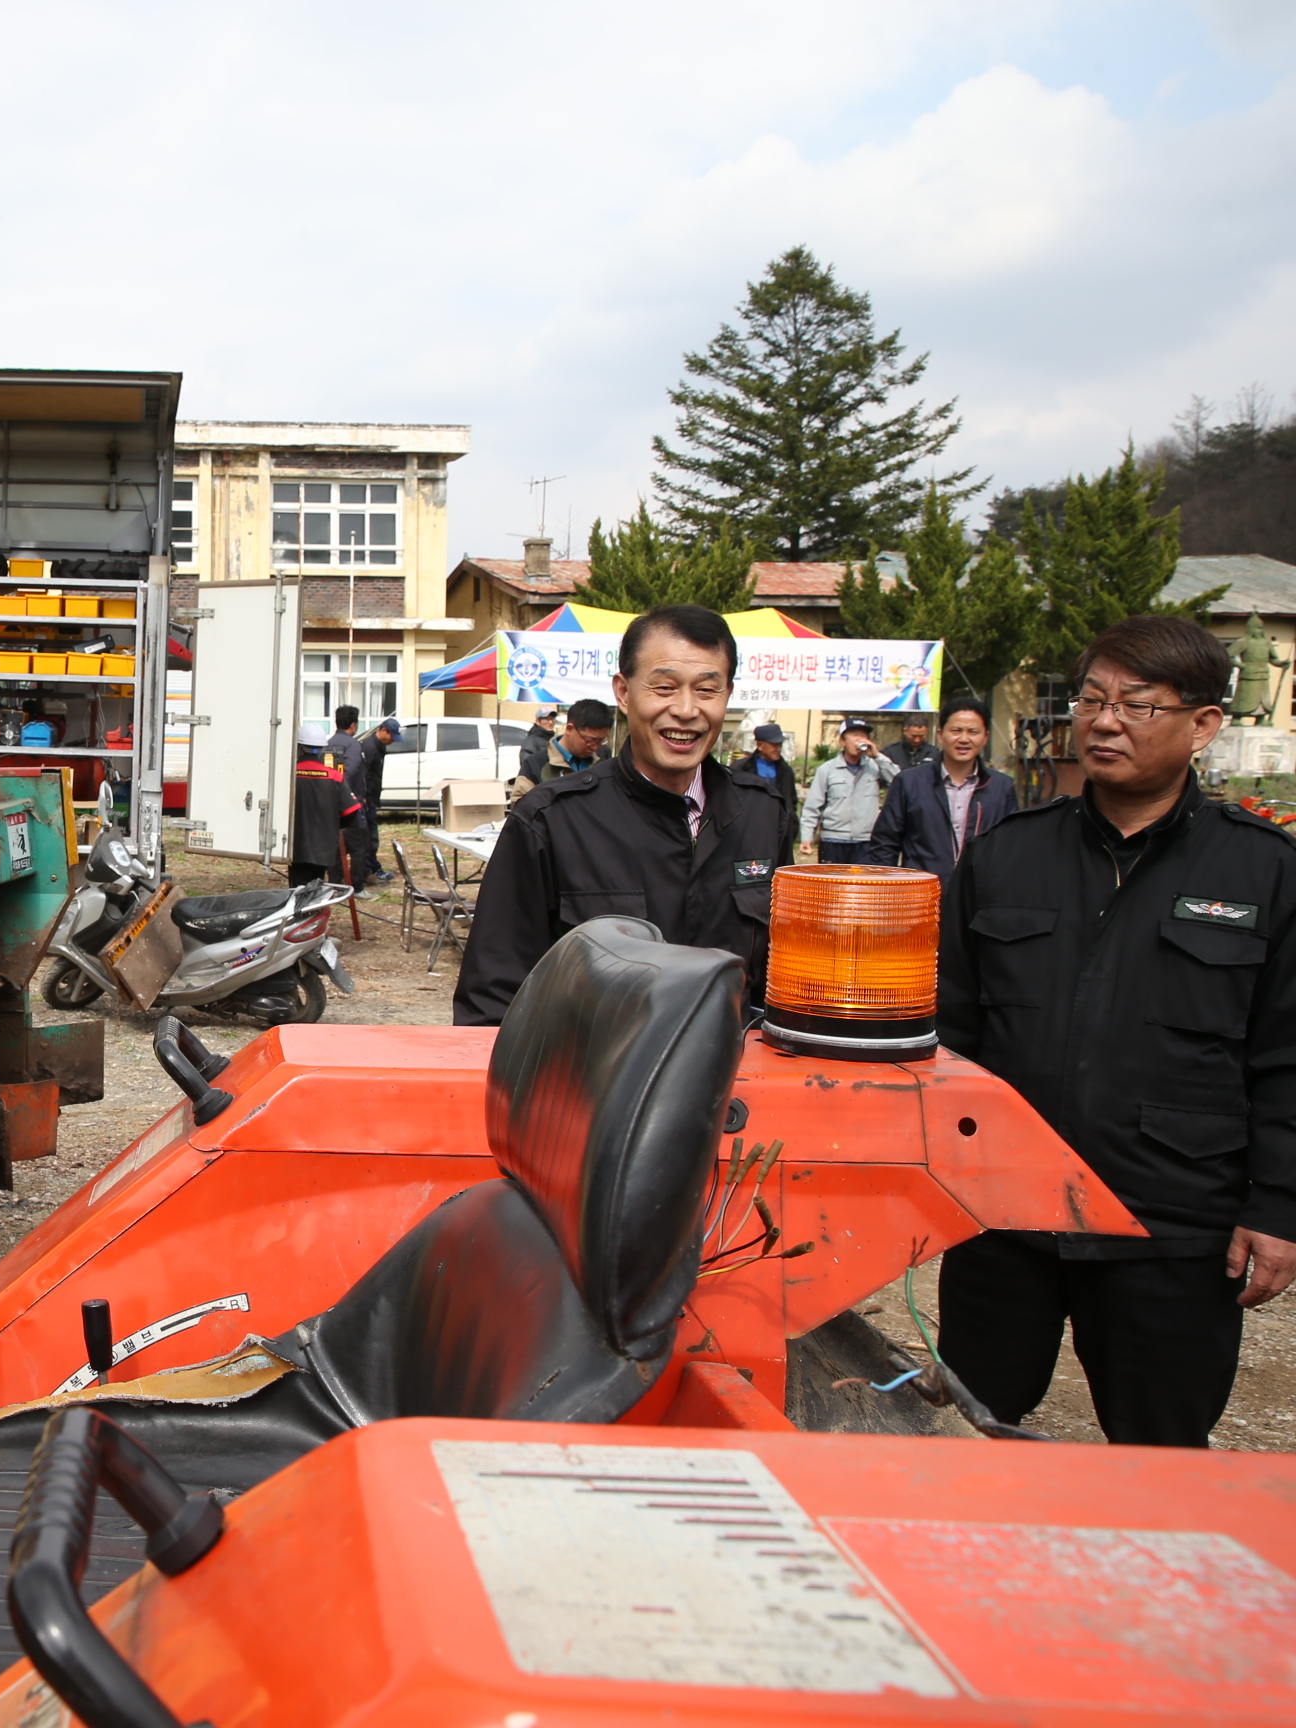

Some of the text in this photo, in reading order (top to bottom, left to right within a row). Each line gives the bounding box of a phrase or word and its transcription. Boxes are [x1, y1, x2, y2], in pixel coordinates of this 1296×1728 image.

[557, 648, 621, 677] 농기계 안
[748, 653, 819, 682] 야광반사판
[824, 655, 851, 683] 부착
[857, 655, 884, 683] 지원
[739, 689, 790, 701] 농업기계팀
